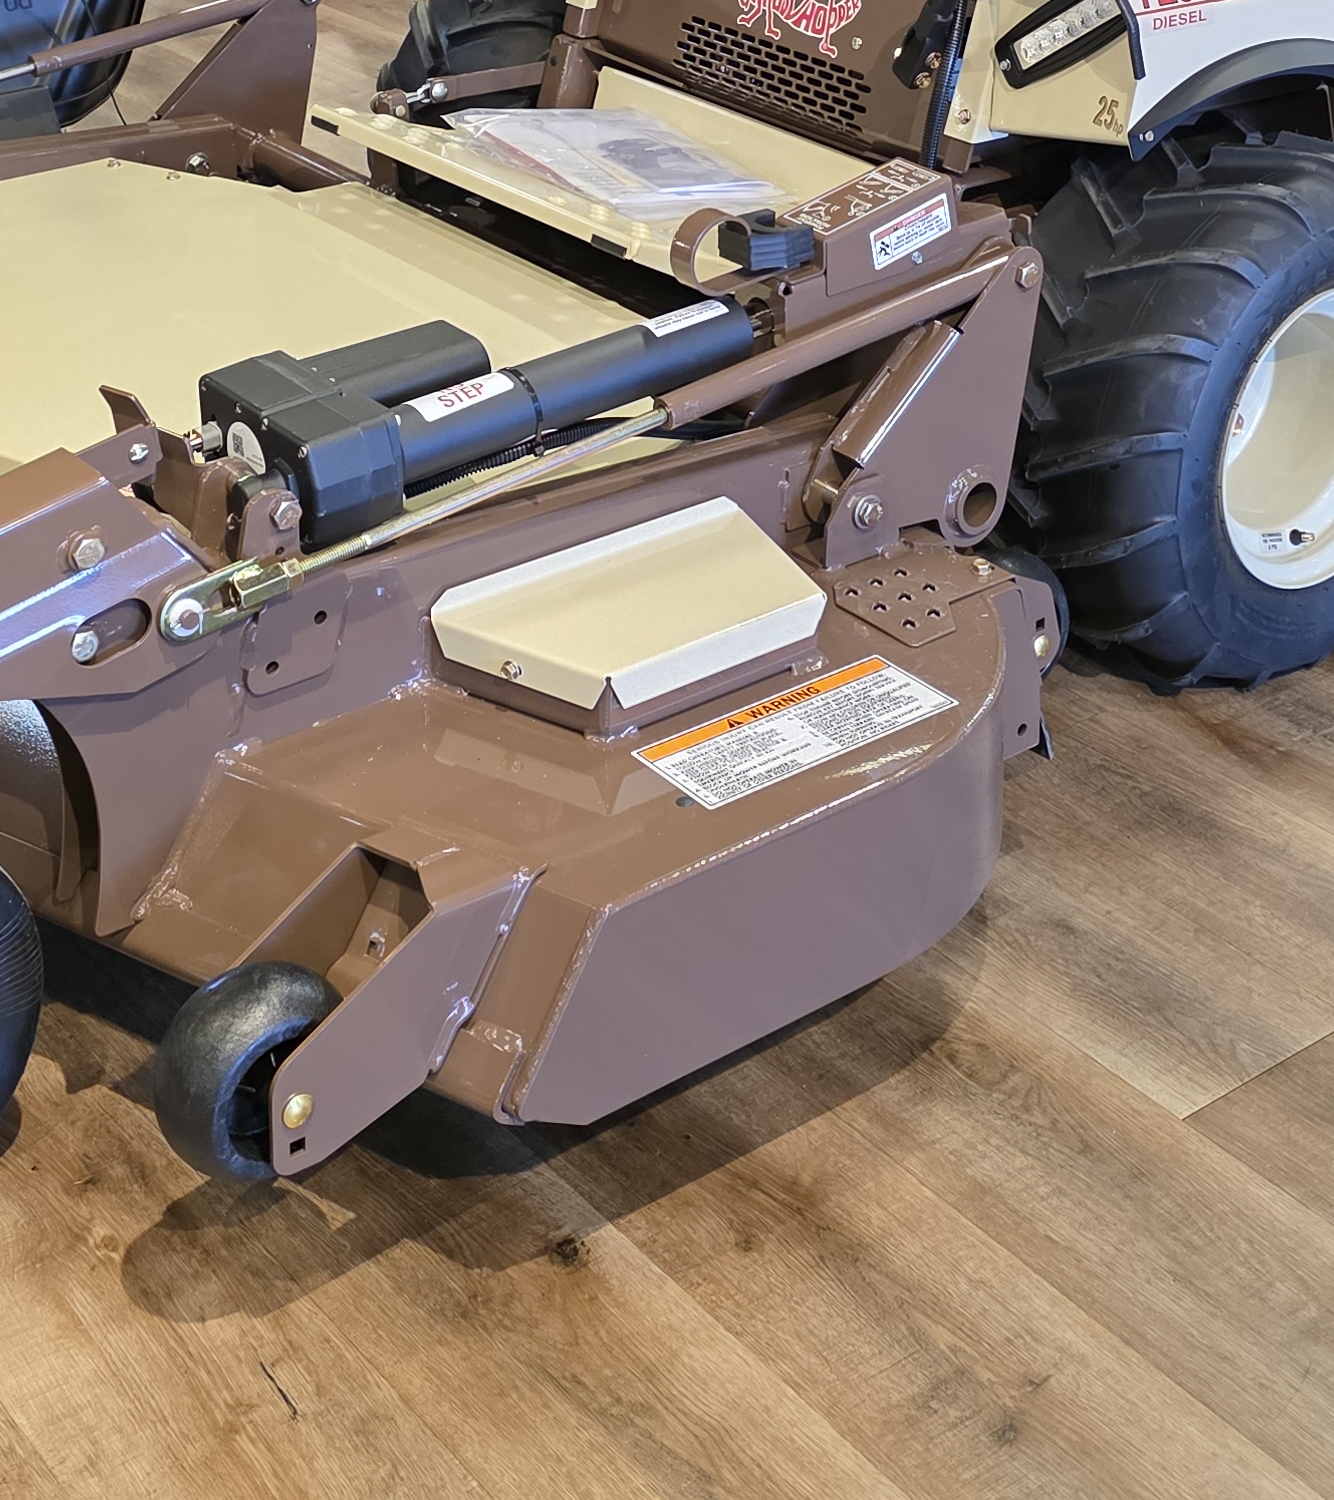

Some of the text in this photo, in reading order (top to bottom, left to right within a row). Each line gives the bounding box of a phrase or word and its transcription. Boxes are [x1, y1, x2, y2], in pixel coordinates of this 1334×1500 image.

[1152, 9, 1207, 30] DIESEL
[902, 210, 926, 226] DANGER
[438, 382, 484, 407] STEP
[745, 685, 822, 720] WARNING
